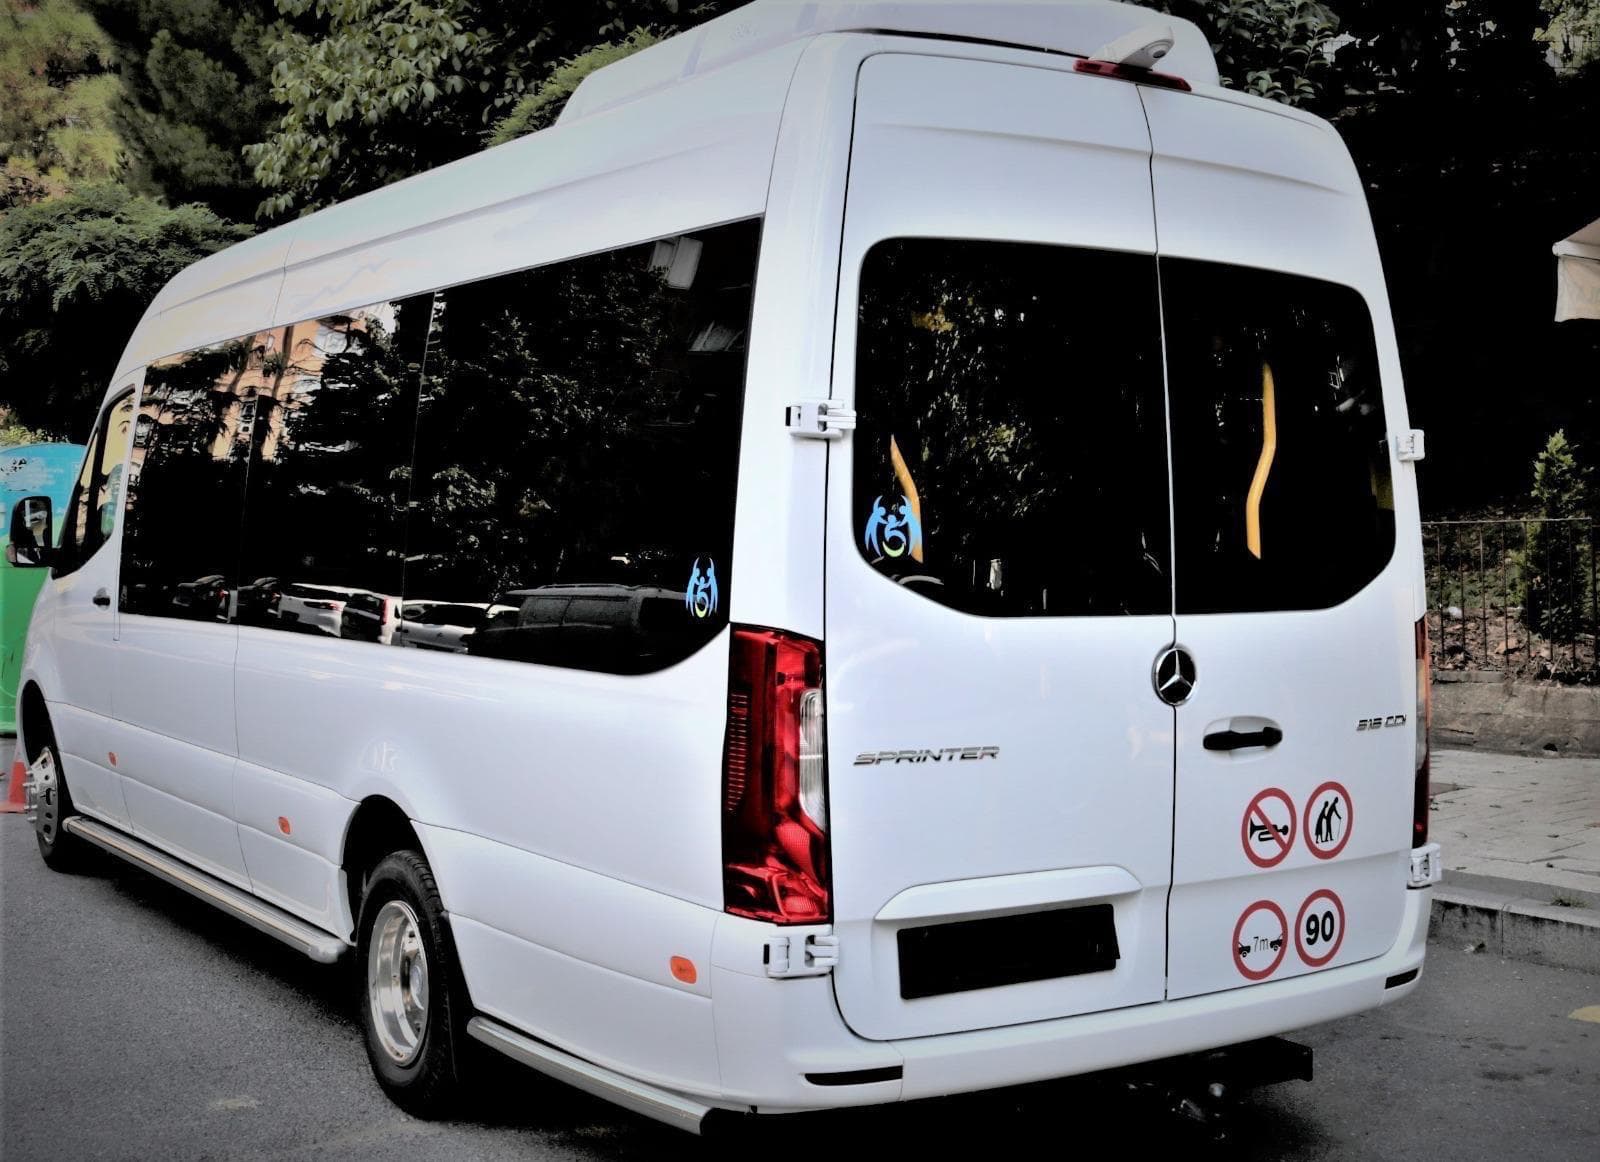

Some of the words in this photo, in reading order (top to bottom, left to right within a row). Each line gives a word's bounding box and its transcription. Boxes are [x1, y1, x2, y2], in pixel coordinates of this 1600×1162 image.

[1384, 714, 1407, 727] CDI
[853, 746, 1000, 766] SPRINTER
[1306, 910, 1334, 945] 90
